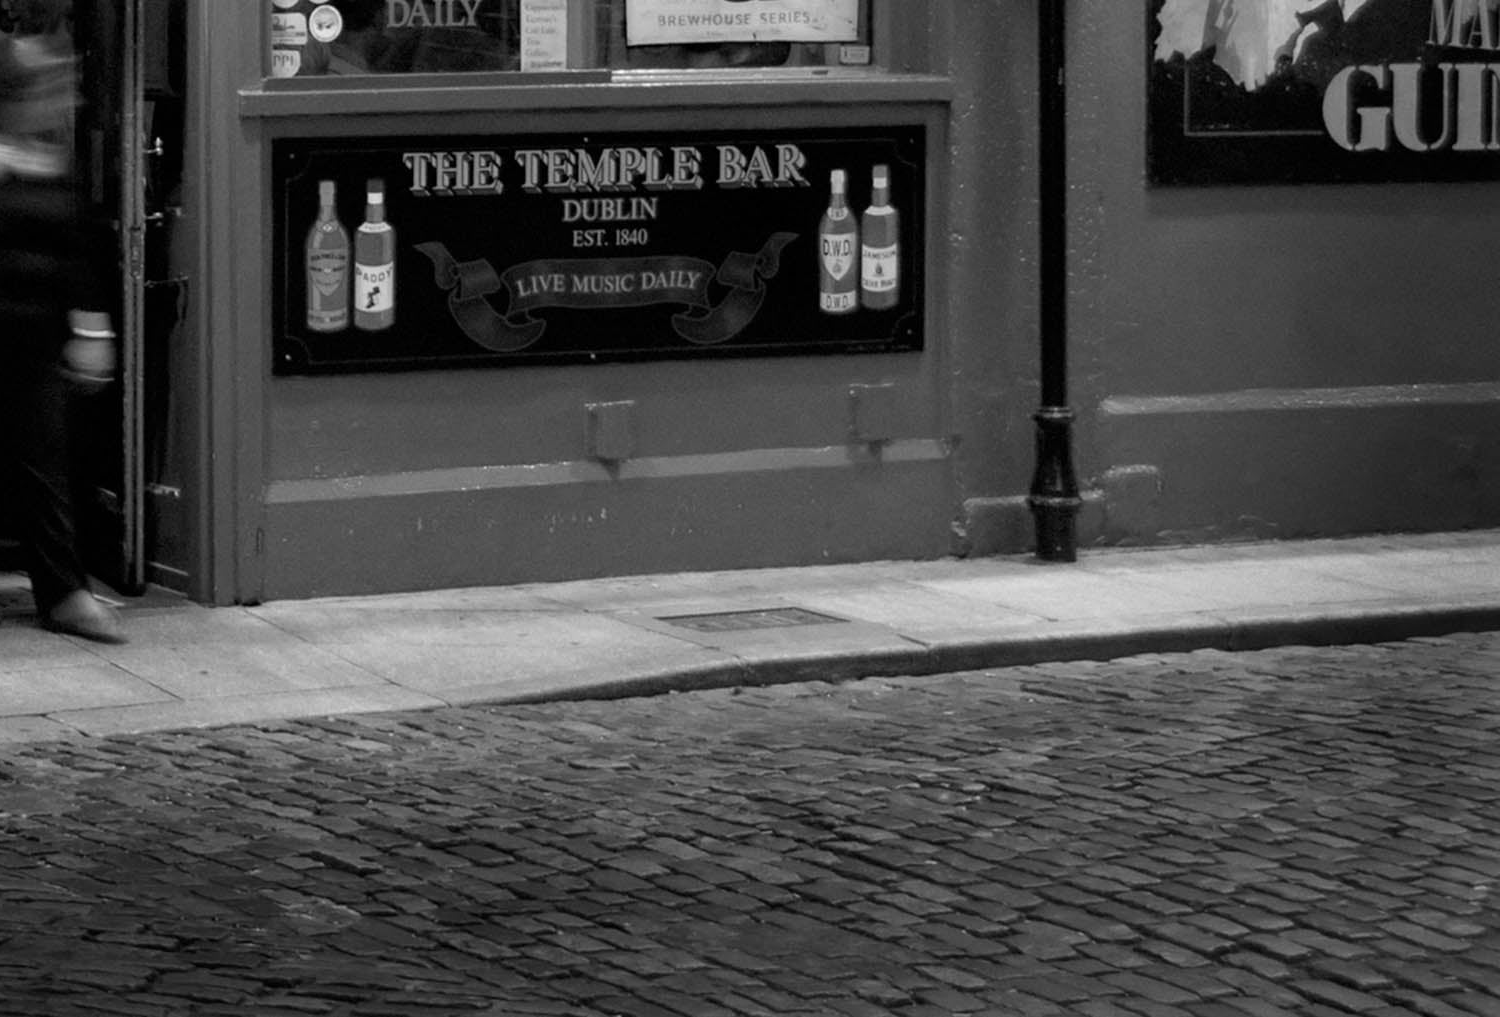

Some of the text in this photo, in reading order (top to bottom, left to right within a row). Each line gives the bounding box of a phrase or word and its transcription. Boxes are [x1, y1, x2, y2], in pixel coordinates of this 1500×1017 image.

[658, 11, 811, 28] BREWHOUSE SERIES
[403, 143, 810, 196] THE TEMPLE BAR
[562, 197, 658, 222] DUBLIN
[572, 229, 649, 247] EST. 1840
[517, 270, 702, 297] LIVE MUSIC DAILY
